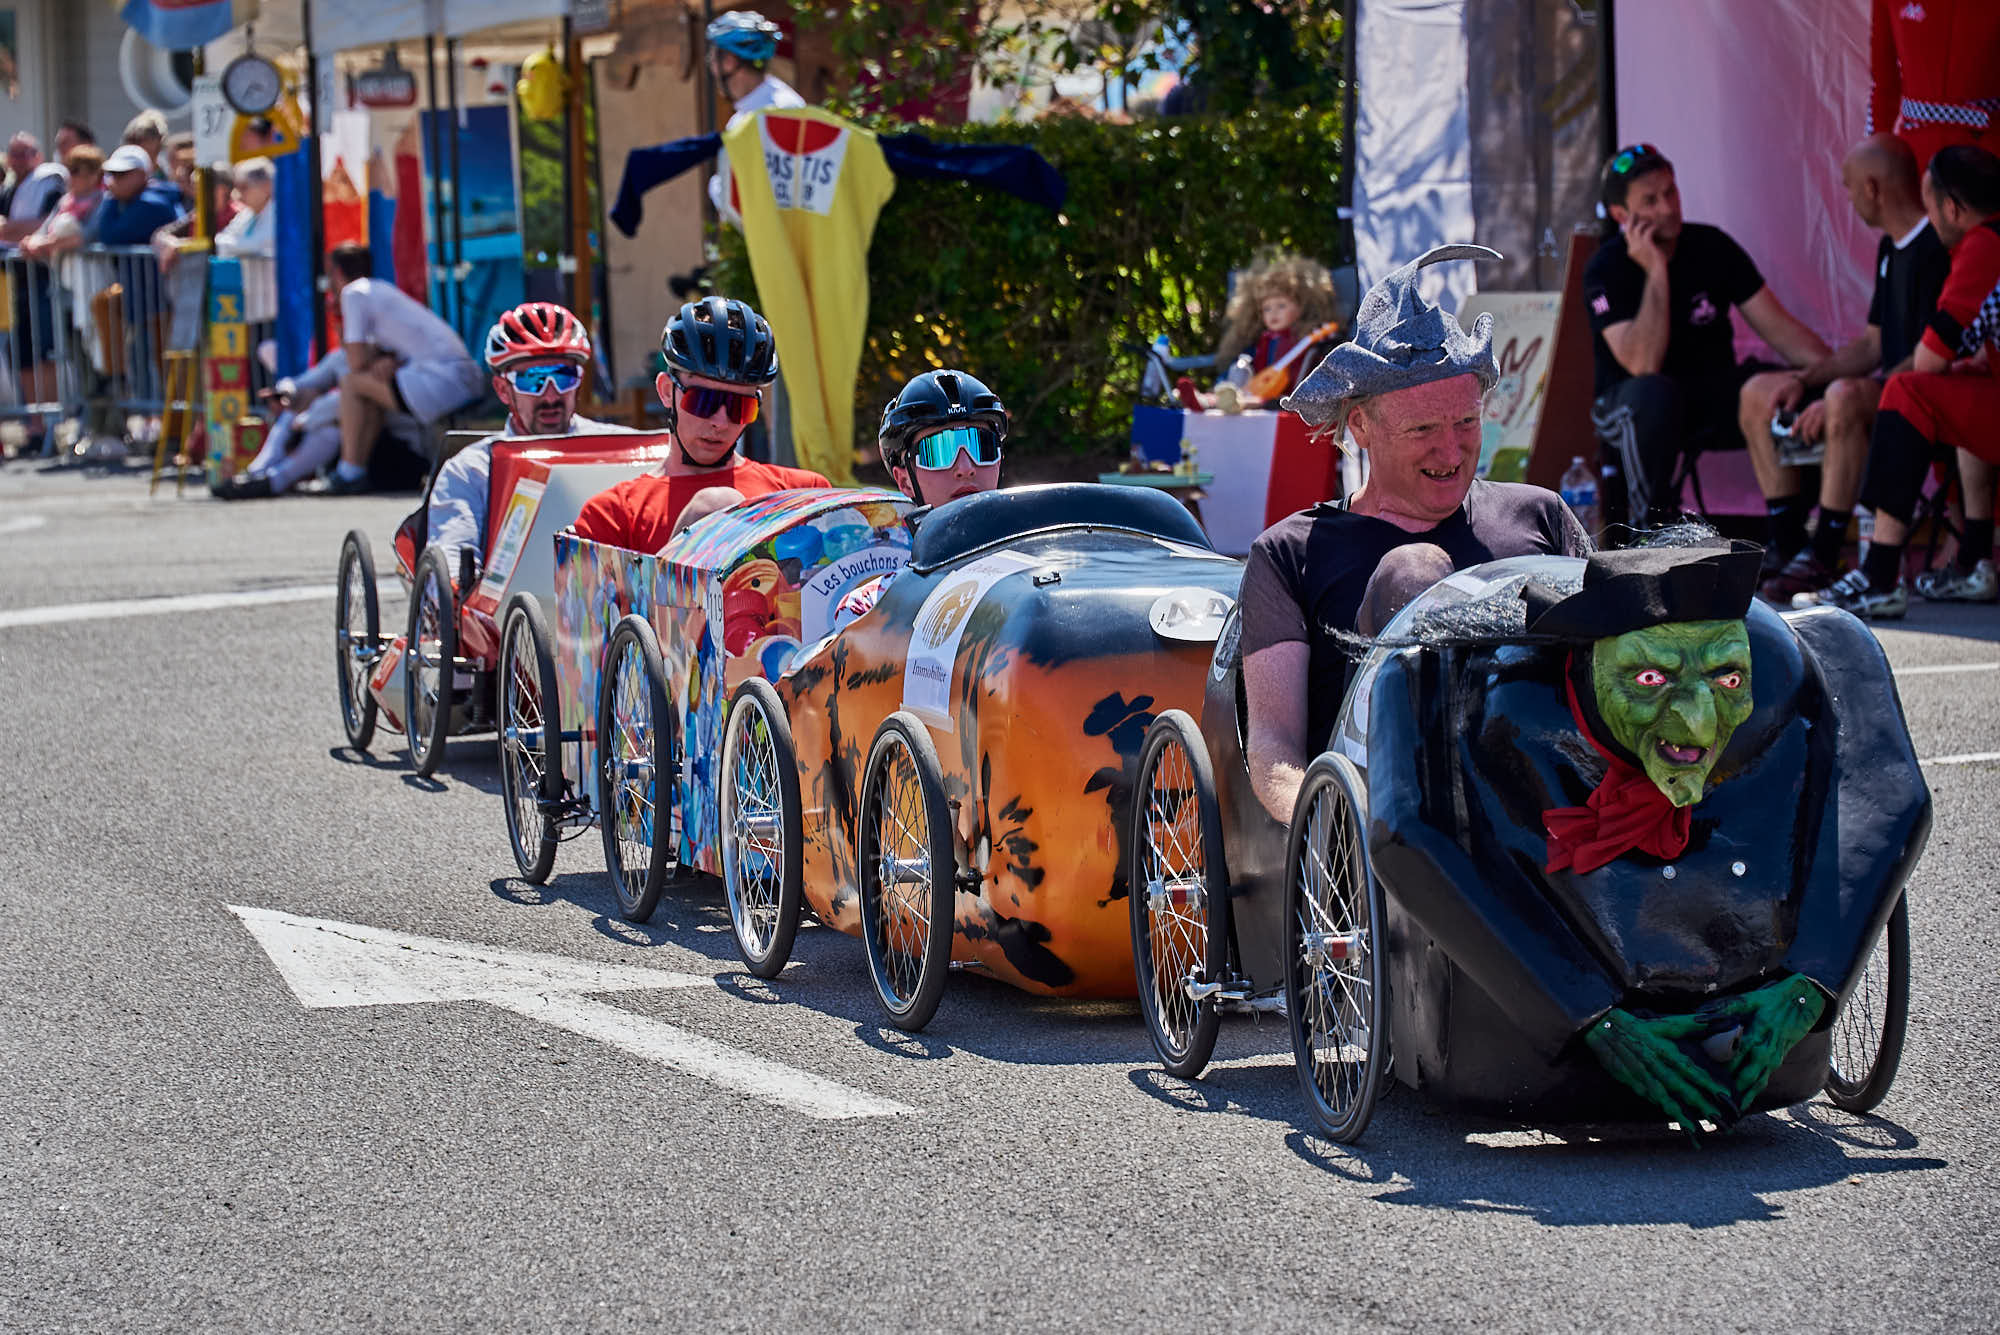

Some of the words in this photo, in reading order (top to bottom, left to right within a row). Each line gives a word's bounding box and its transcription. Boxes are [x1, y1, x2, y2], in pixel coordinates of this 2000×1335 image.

[775, 182, 814, 201] CLB
[811, 572, 841, 597] Les
[838, 552, 899, 580] bouchons
[709, 593, 723, 622] 119
[911, 659, 947, 682] Immobilier
